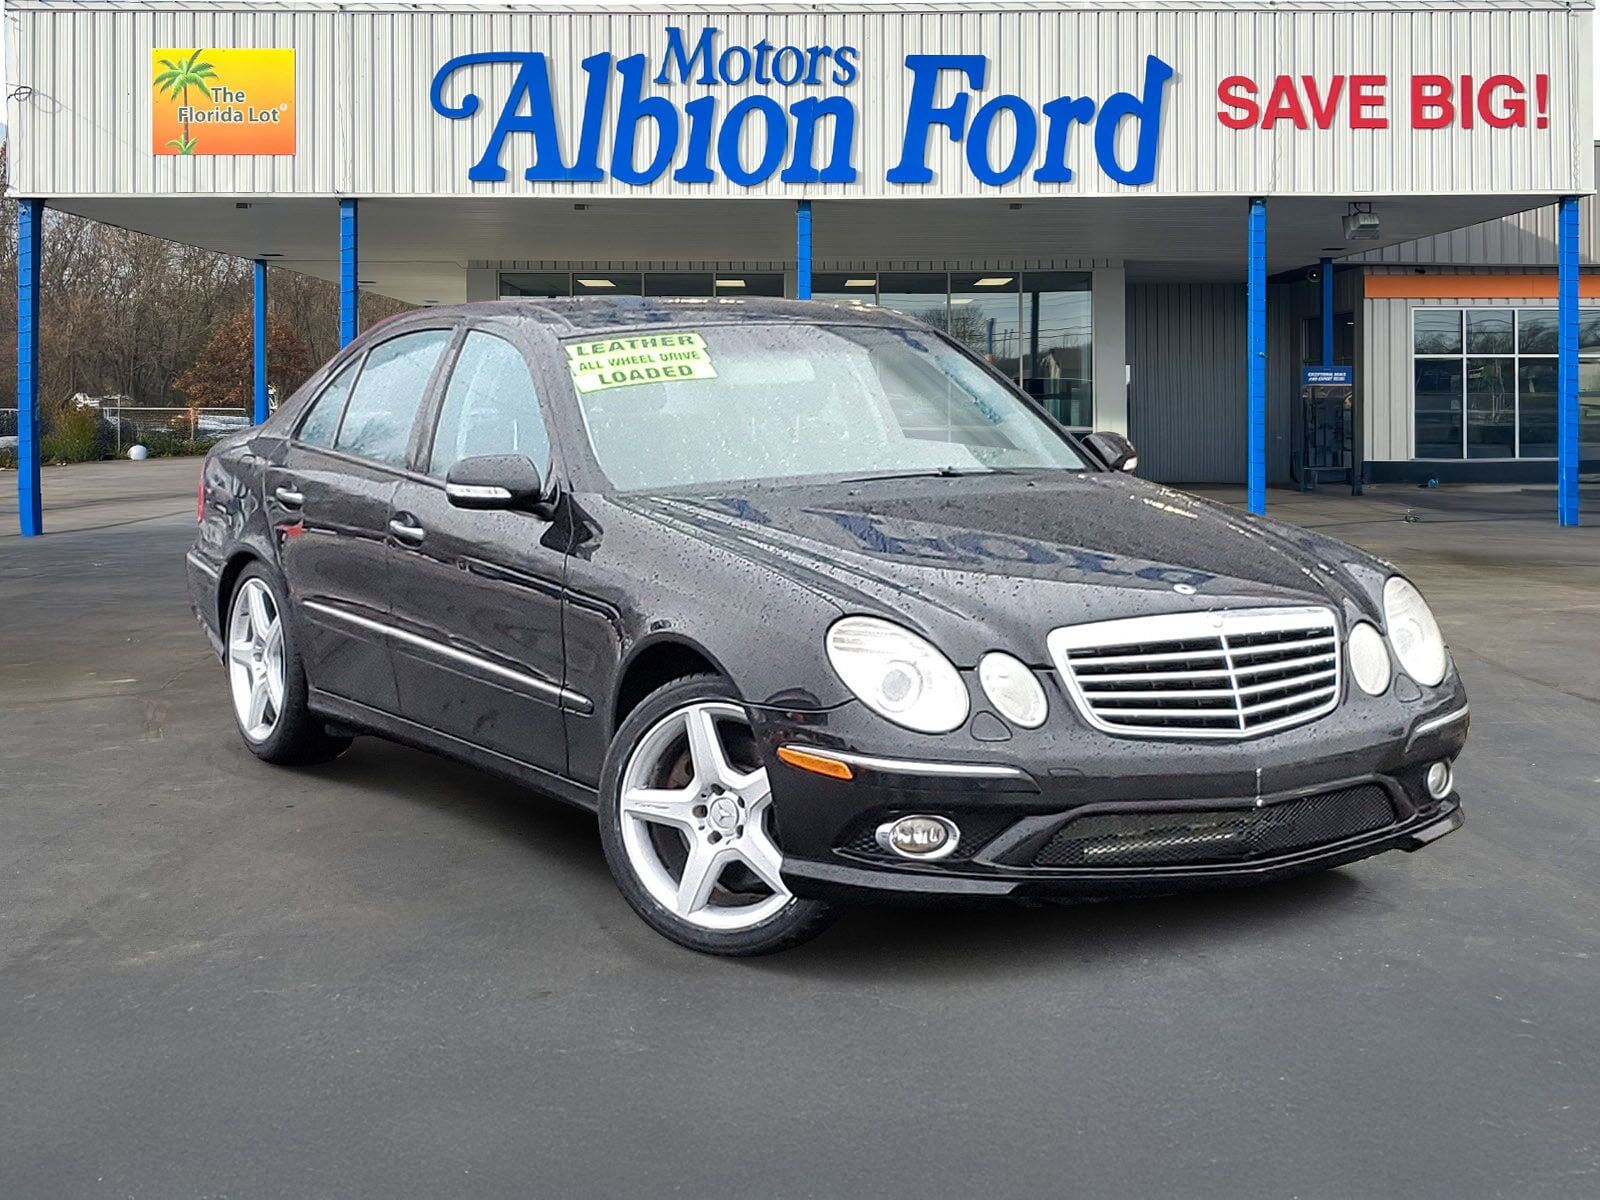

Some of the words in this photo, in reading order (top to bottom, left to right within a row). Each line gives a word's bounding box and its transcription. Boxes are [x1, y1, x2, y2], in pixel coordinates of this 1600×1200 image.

[654, 26, 858, 85] Motors
[211, 87, 246, 103] The
[1217, 75, 1388, 129] SAVE
[1411, 75, 1549, 129] BIG!
[178, 107, 243, 122] Florida
[249, 107, 279, 122] Lot
[430, 51, 857, 186] Albion
[886, 55, 1173, 186] Ford
[576, 335, 695, 356] LEATHER
[579, 361, 605, 371] ALL
[608, 354, 656, 366] WHEEL
[660, 350, 701, 362] DRIVE
[598, 364, 694, 385] LOADED
